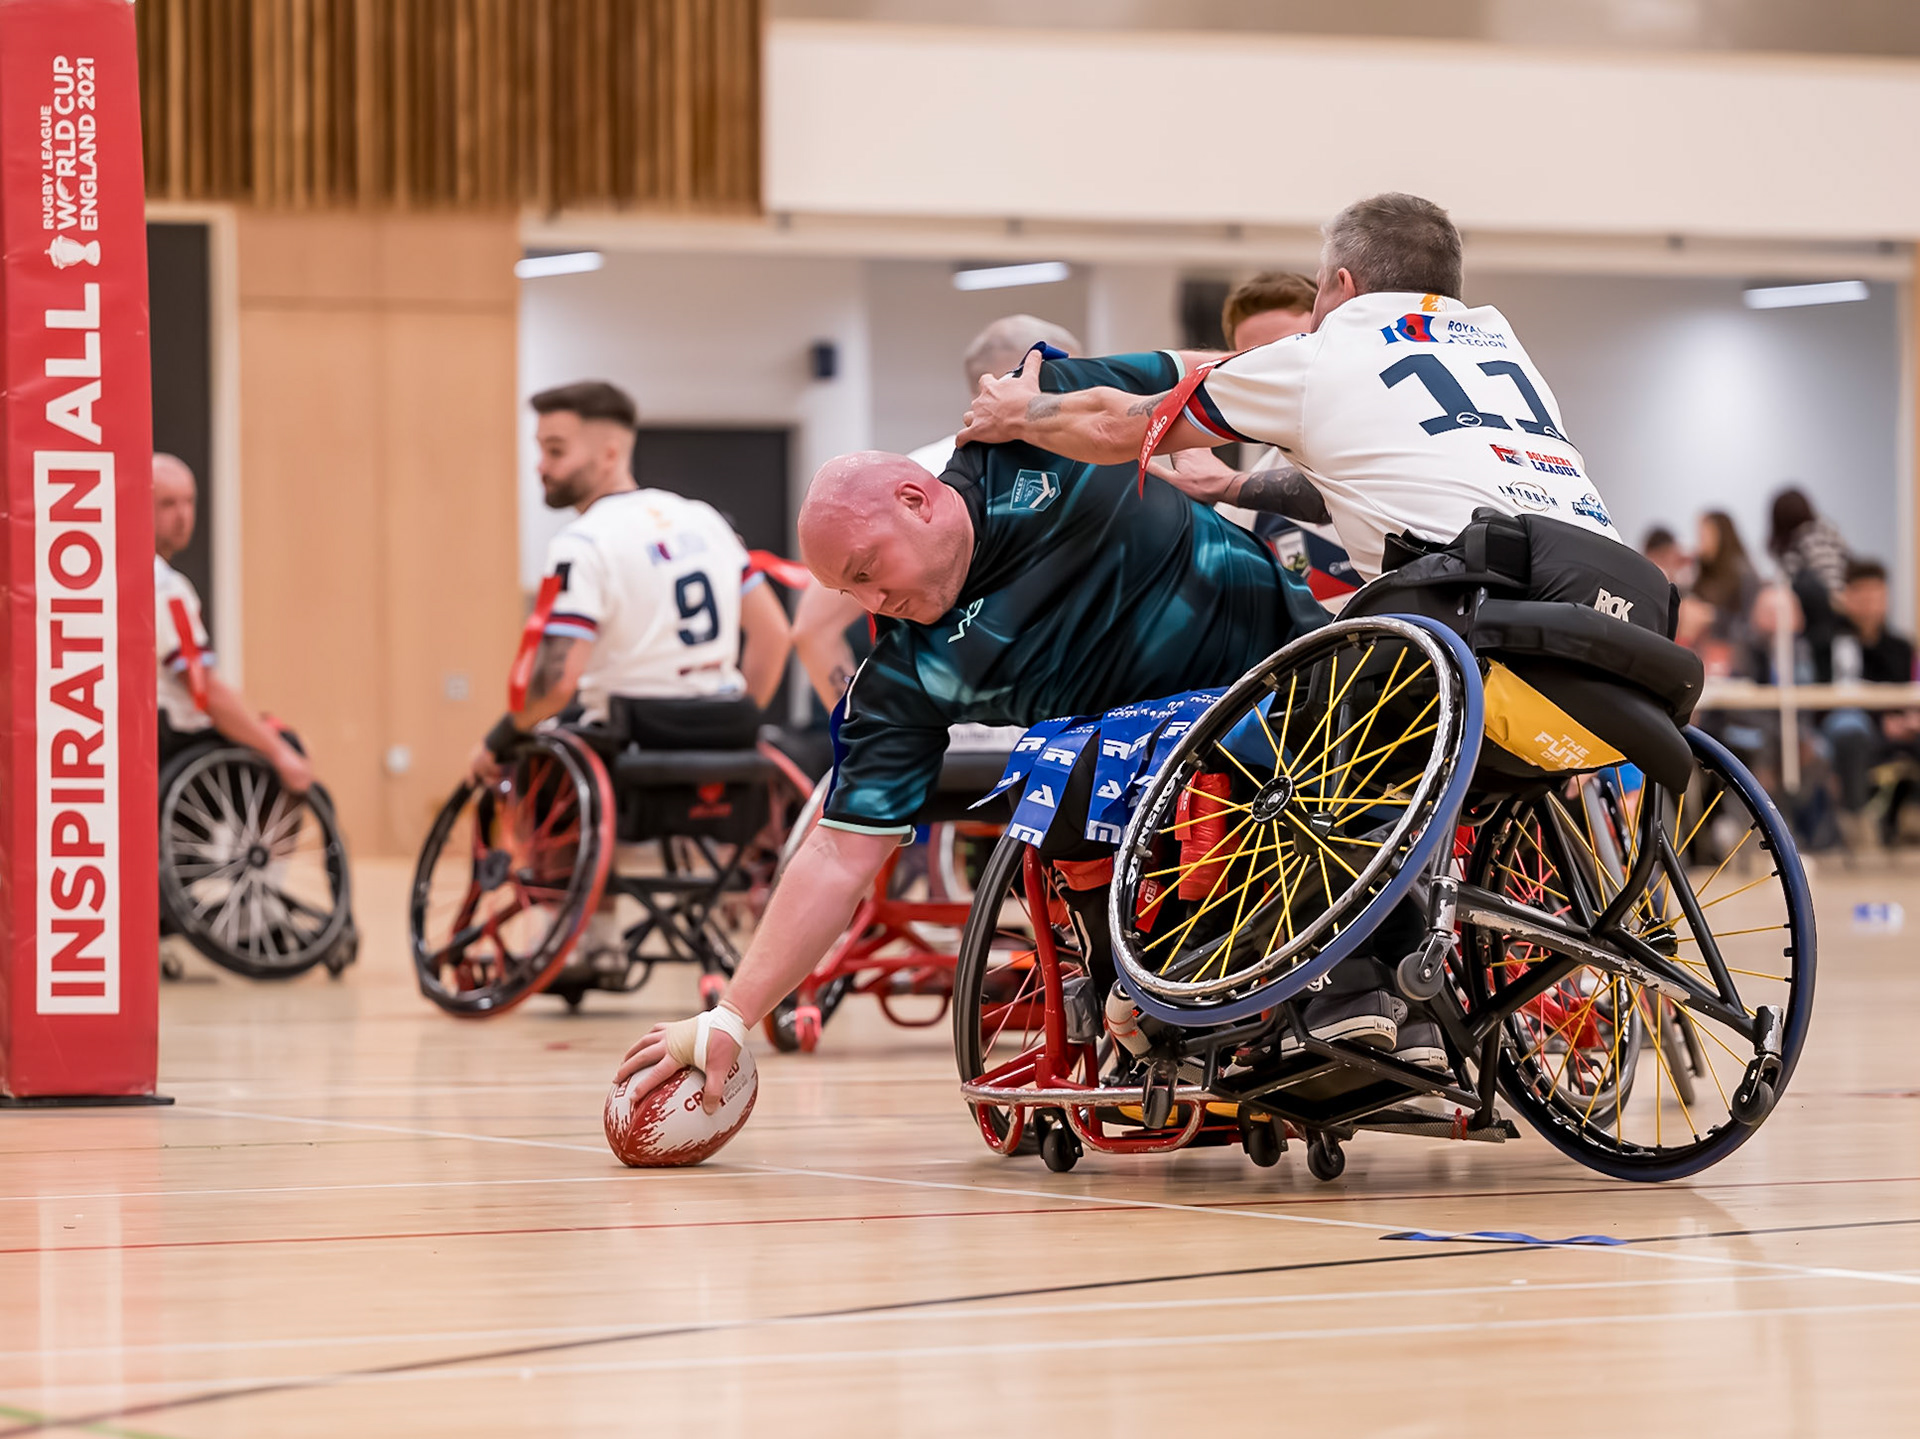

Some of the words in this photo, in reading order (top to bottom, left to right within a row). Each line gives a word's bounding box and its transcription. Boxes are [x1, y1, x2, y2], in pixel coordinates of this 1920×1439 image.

[53, 55, 75, 115] CUP
[76, 57, 95, 111] 2021
[40, 105, 53, 170] LEAGUE
[42, 173, 55, 230] RUGBY
[78, 114, 98, 231] ENGLAND
[45, 283, 102, 444] ALL
[1379, 354, 1577, 449] 11
[1498, 485, 1558, 507] INTOUCH
[1531, 460, 1581, 478] LEAGUE
[675, 571, 719, 646] 9
[48, 469, 105, 997] INSPIRATION
[1540, 751, 1559, 762] OF
[1560, 734, 1590, 758] THE
